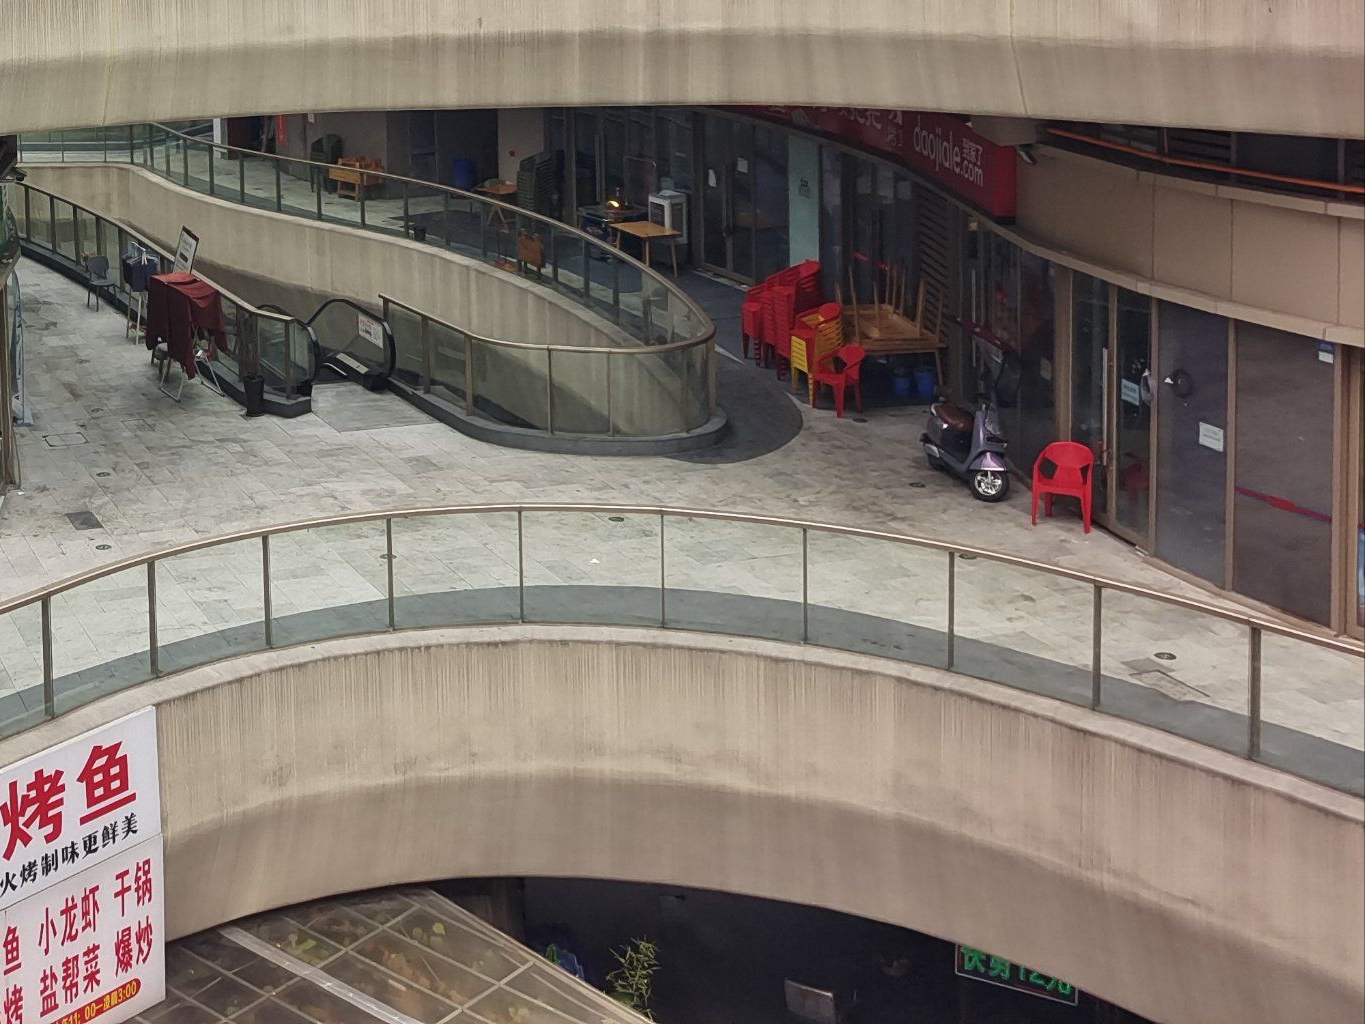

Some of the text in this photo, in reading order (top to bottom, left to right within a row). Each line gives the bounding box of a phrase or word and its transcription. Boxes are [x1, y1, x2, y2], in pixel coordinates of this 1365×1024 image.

[38, 884, 101, 957] 小龙虾
[114, 858, 153, 918] 干锅
[114, 915, 154, 977] 爆炒
[39, 943, 102, 1019] 盐帮菜
